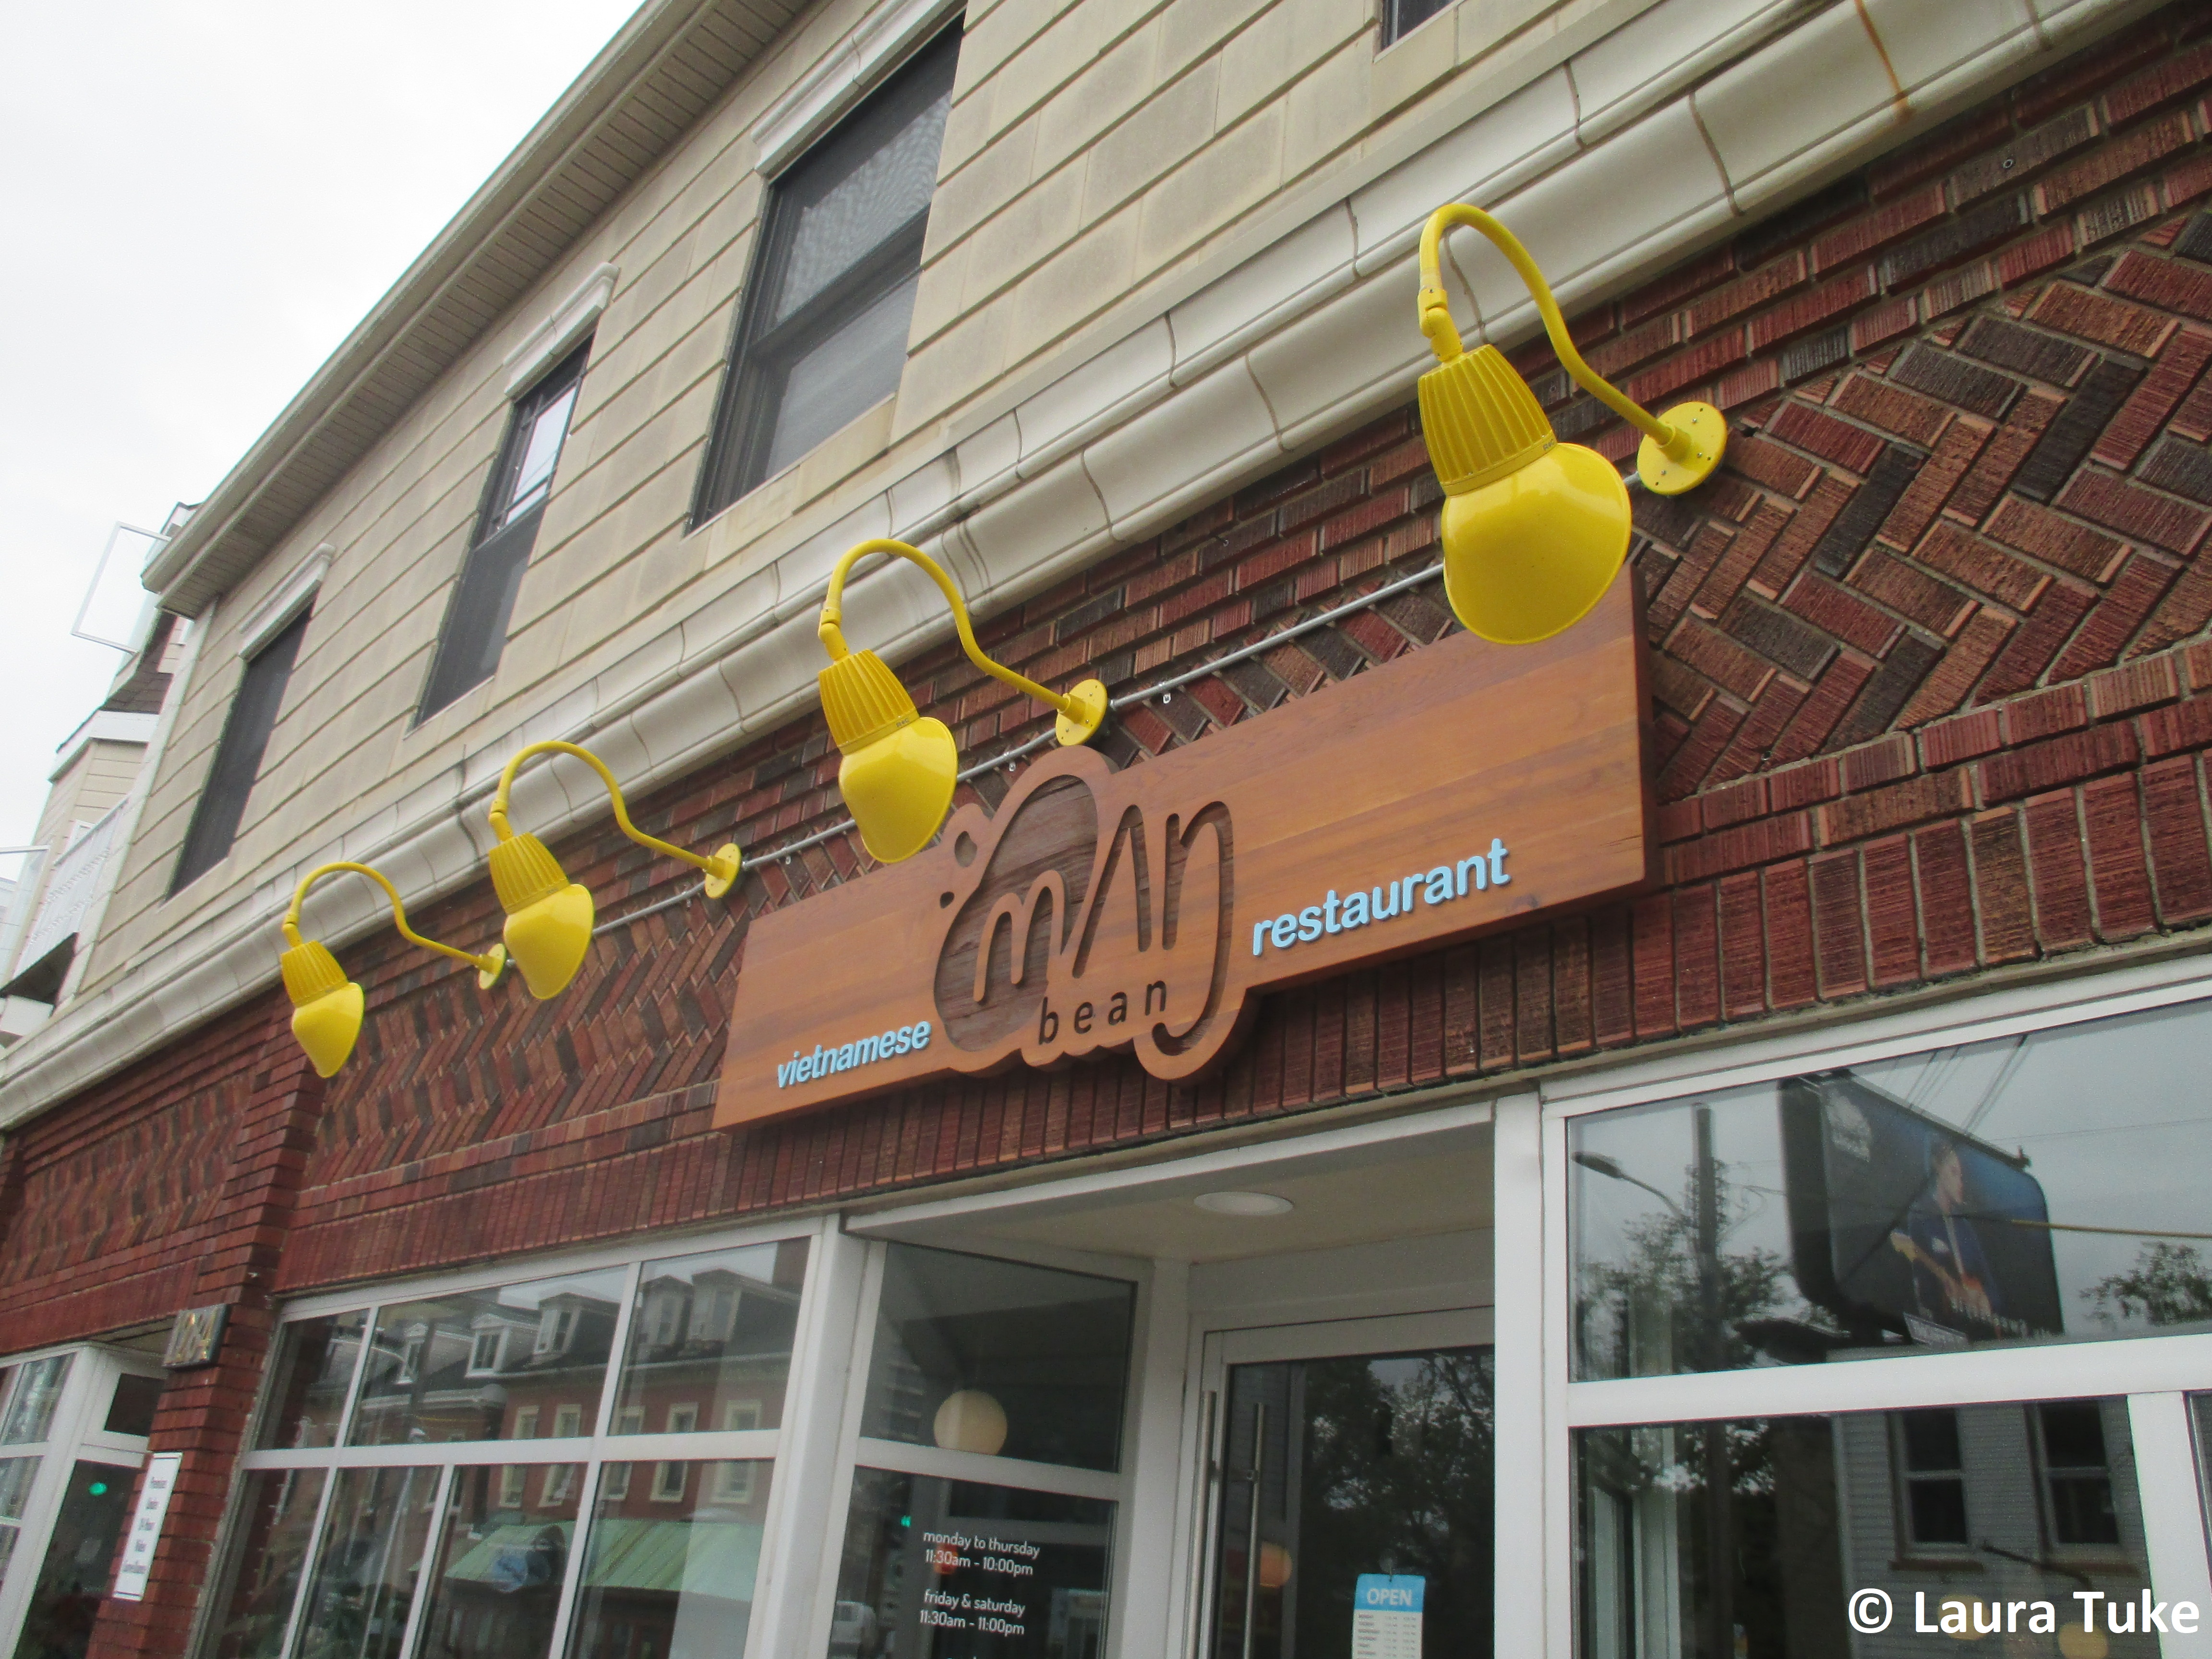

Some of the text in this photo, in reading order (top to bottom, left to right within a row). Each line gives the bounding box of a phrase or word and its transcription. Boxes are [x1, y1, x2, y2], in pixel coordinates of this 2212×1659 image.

[1252, 838, 1511, 956] restaurant
[1038, 980, 1167, 1045] bean
[778, 1021, 932, 1088] vietnamese
[923, 1532, 1040, 1560] monday to thursday
[926, 1549, 971, 1568] 11:30am
[983, 1556, 1033, 1577] 10:00pm
[924, 1588, 1026, 1618] friday & saturday
[1367, 1587, 1413, 1607] OPEN
[920, 1609, 966, 1629] 11:30am
[978, 1616, 1025, 1637] 11:00pm
